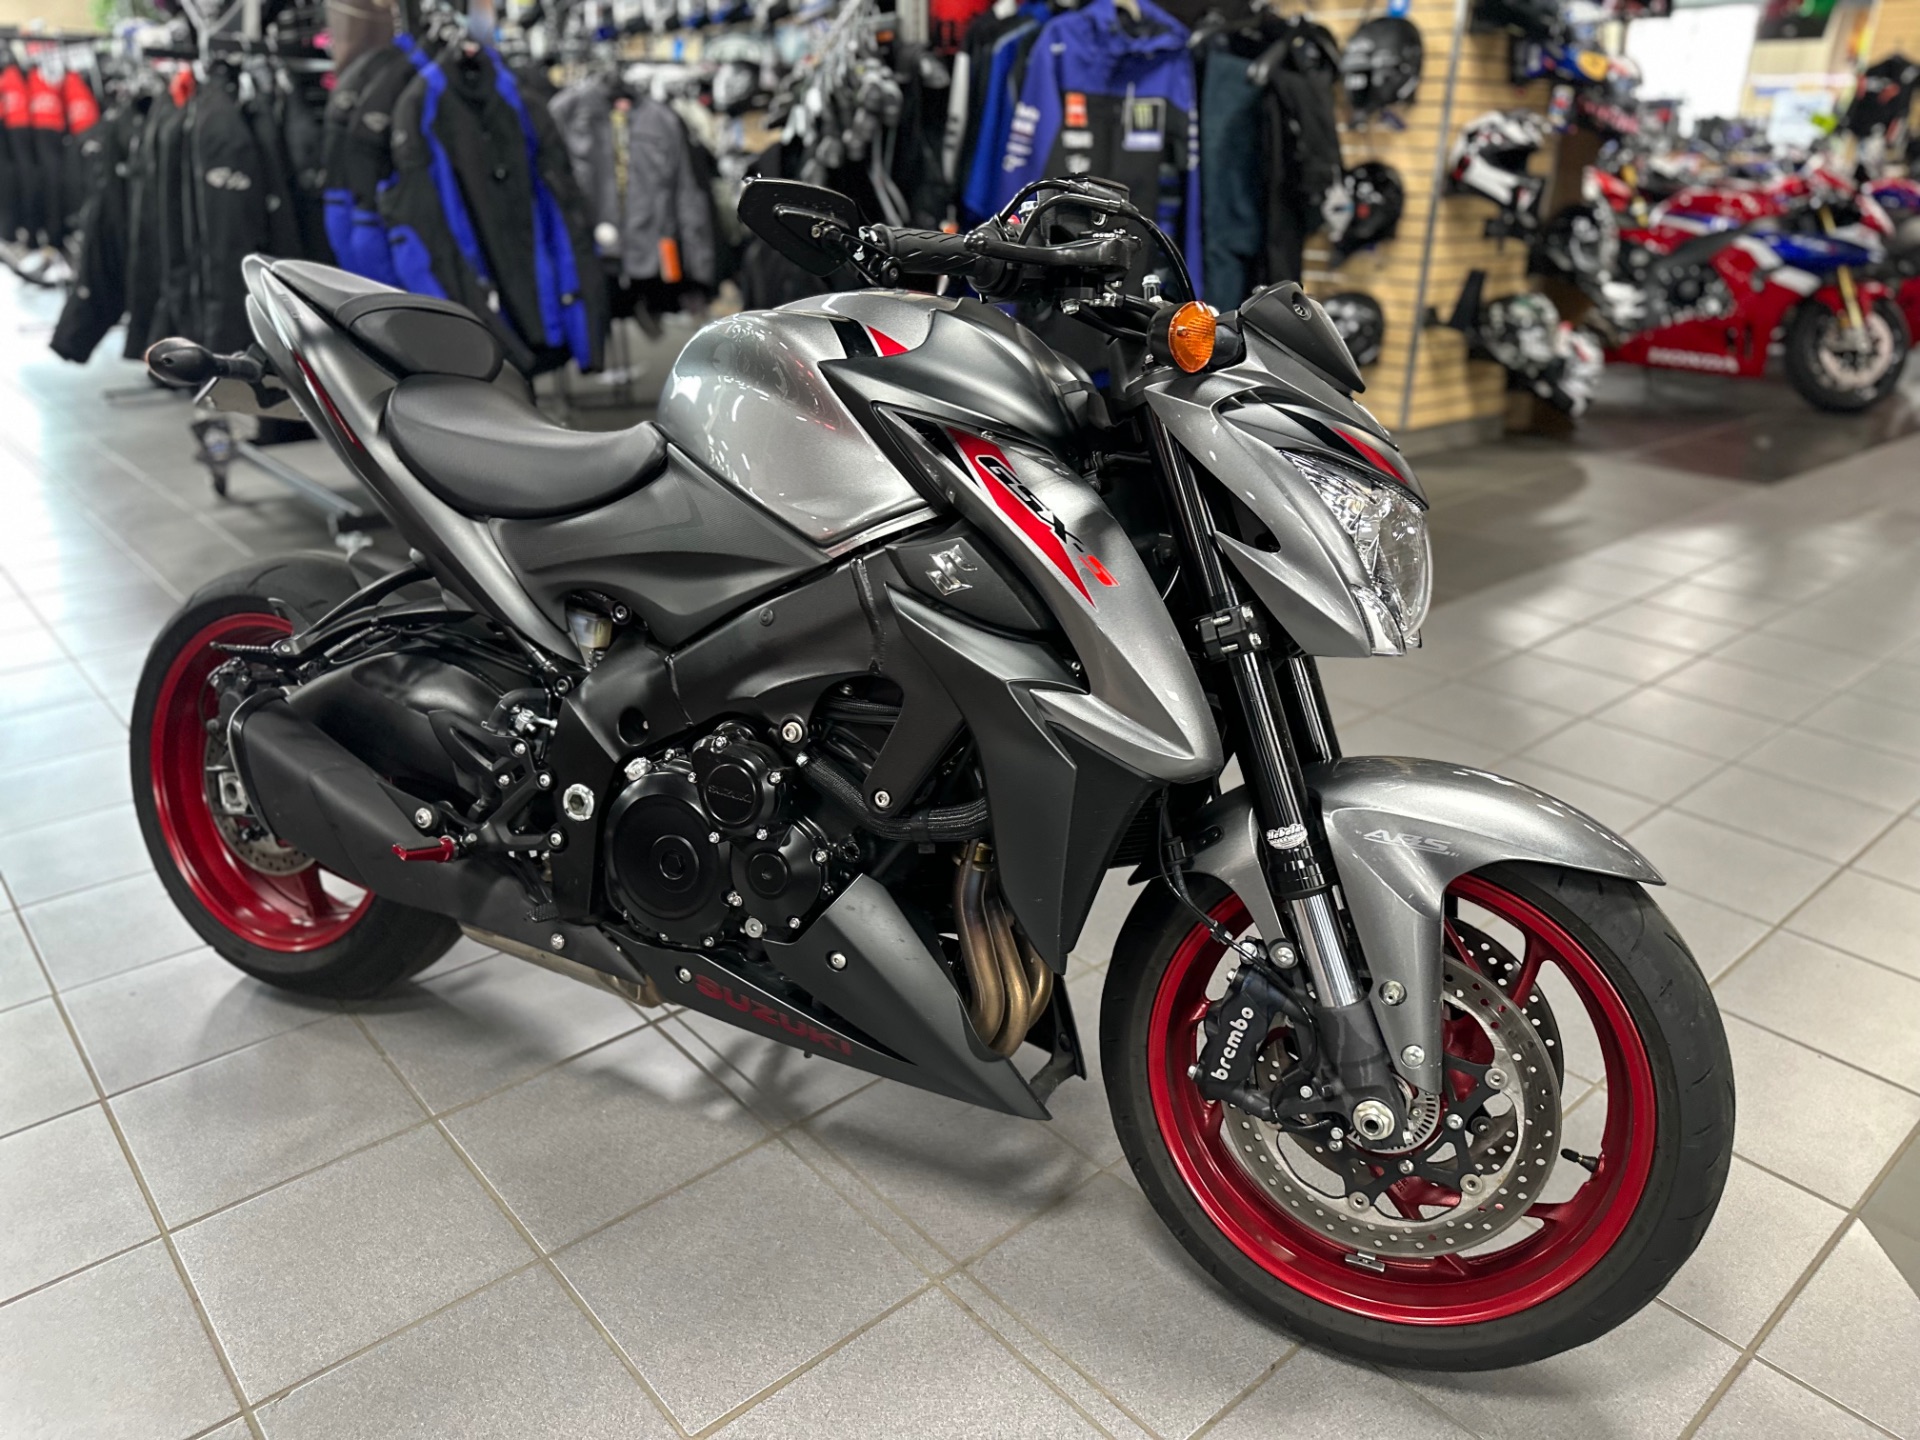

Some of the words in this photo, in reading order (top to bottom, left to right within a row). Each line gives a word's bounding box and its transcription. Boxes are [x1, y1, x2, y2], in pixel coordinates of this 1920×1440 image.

[975, 455, 1120, 587] GSX-S
[1363, 829, 1452, 853] ABS
[695, 974, 853, 1056] SUZUKI
[1210, 1006, 1254, 1081] brembo
